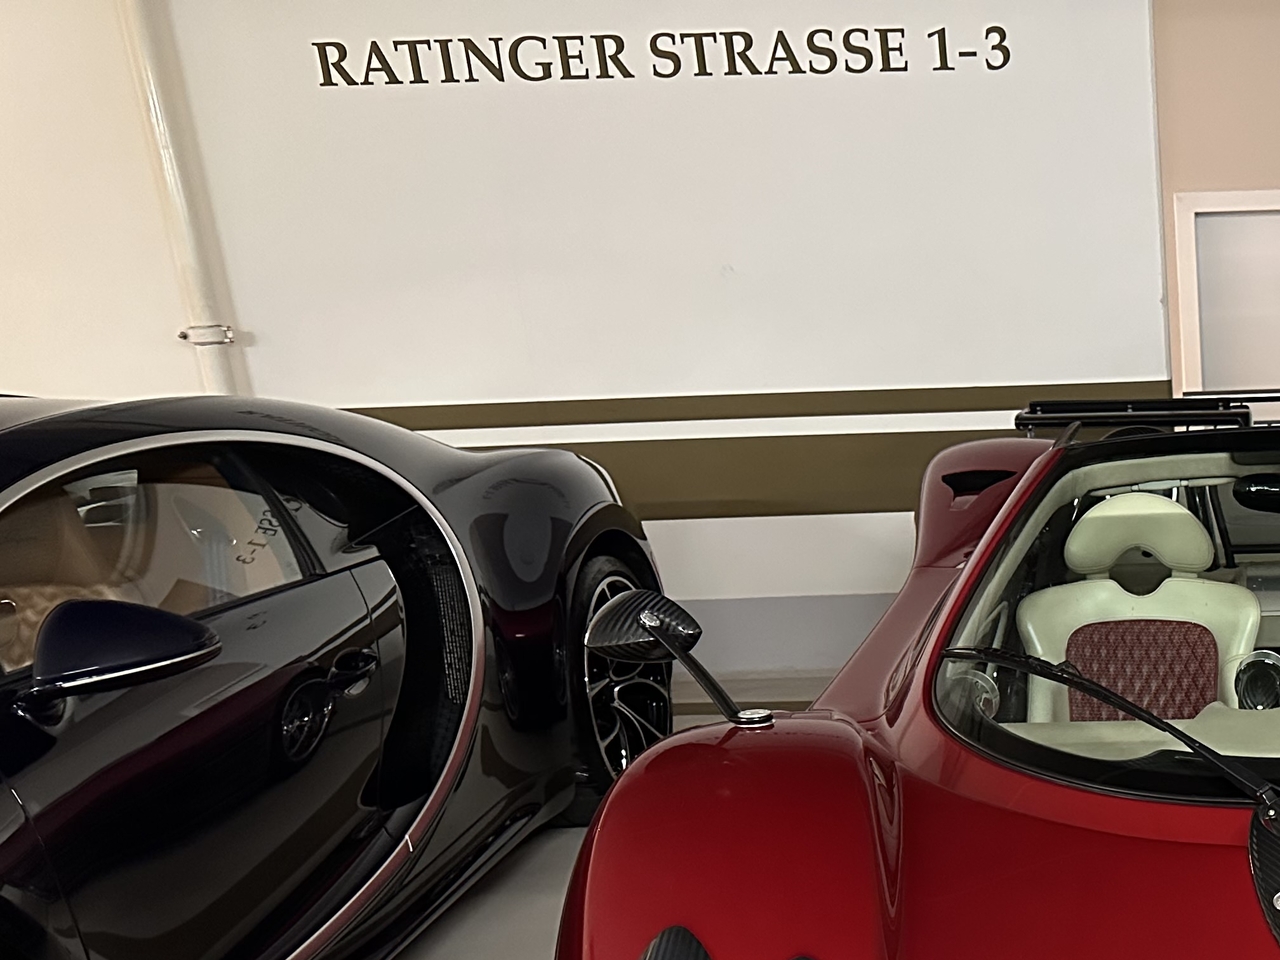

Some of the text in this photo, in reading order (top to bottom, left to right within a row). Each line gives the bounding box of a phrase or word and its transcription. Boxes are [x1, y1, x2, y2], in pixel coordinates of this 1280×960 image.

[311, 25, 1011, 87] RATINGER STRASSE 1-3
